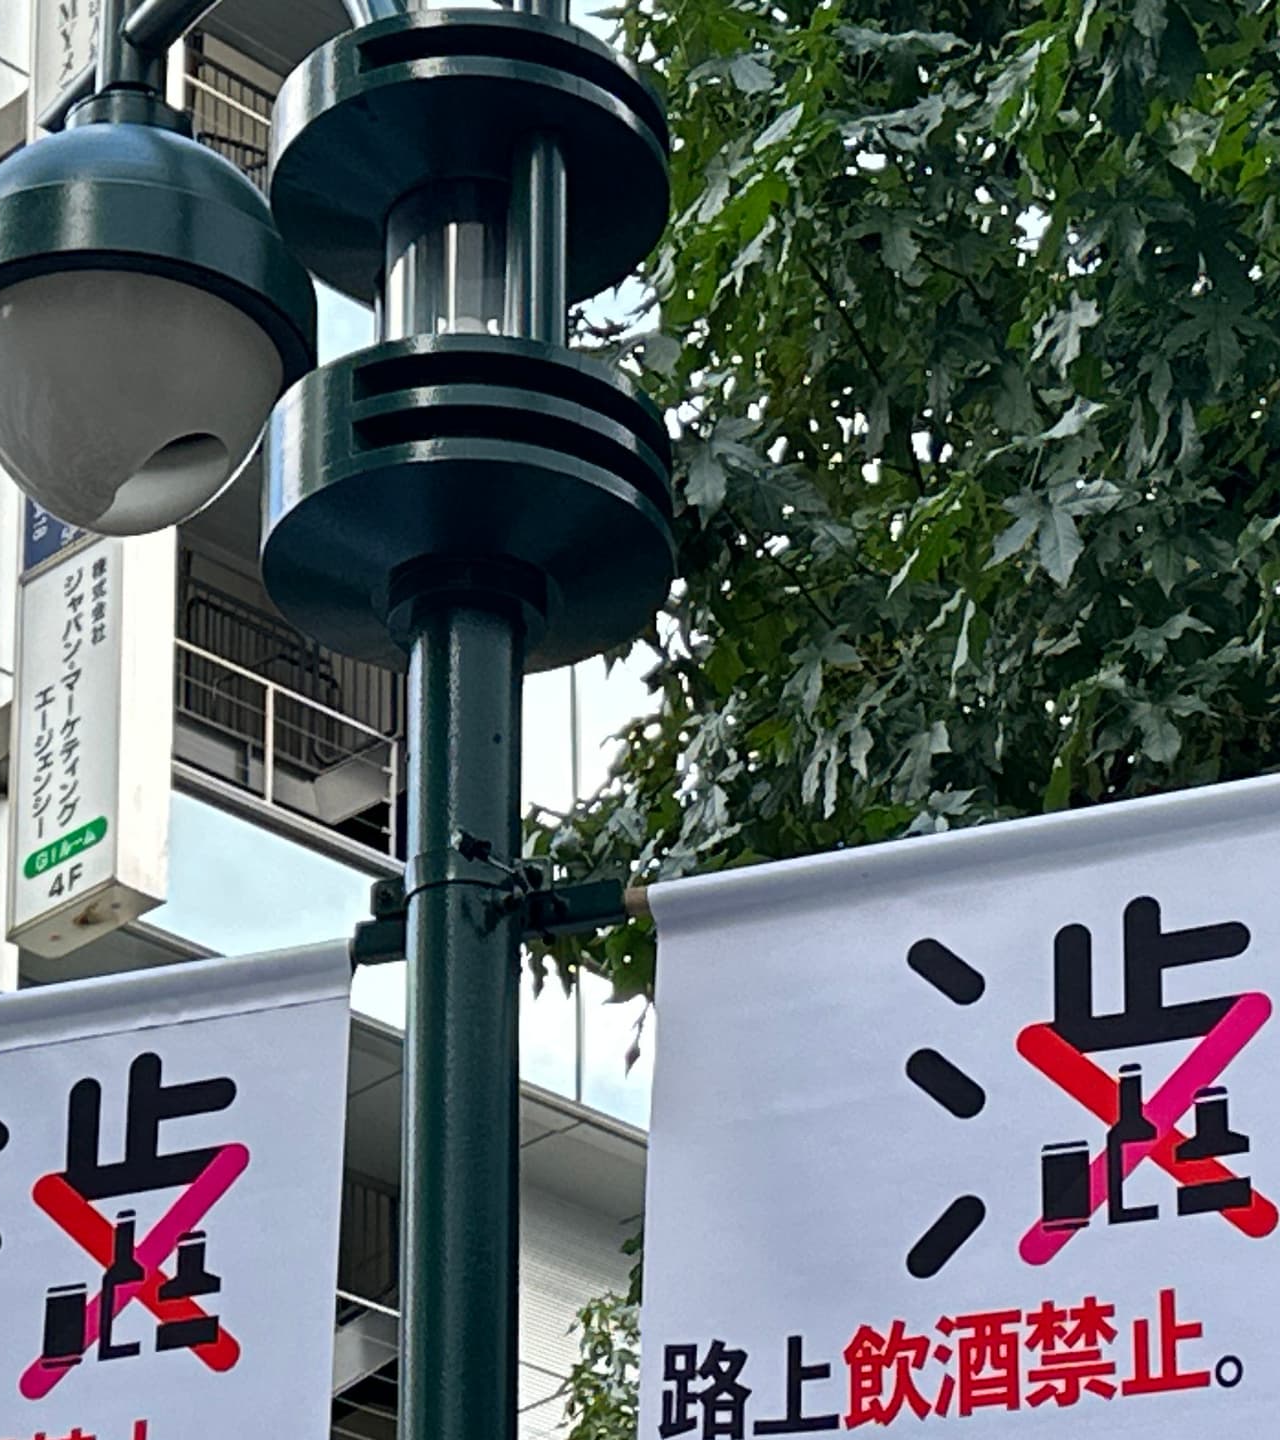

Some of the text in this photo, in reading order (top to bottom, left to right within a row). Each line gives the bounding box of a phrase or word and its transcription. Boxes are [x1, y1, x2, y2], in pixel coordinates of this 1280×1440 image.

[32, 684, 56, 839] エージェンシー
[48, 862, 83, 898] 4F
